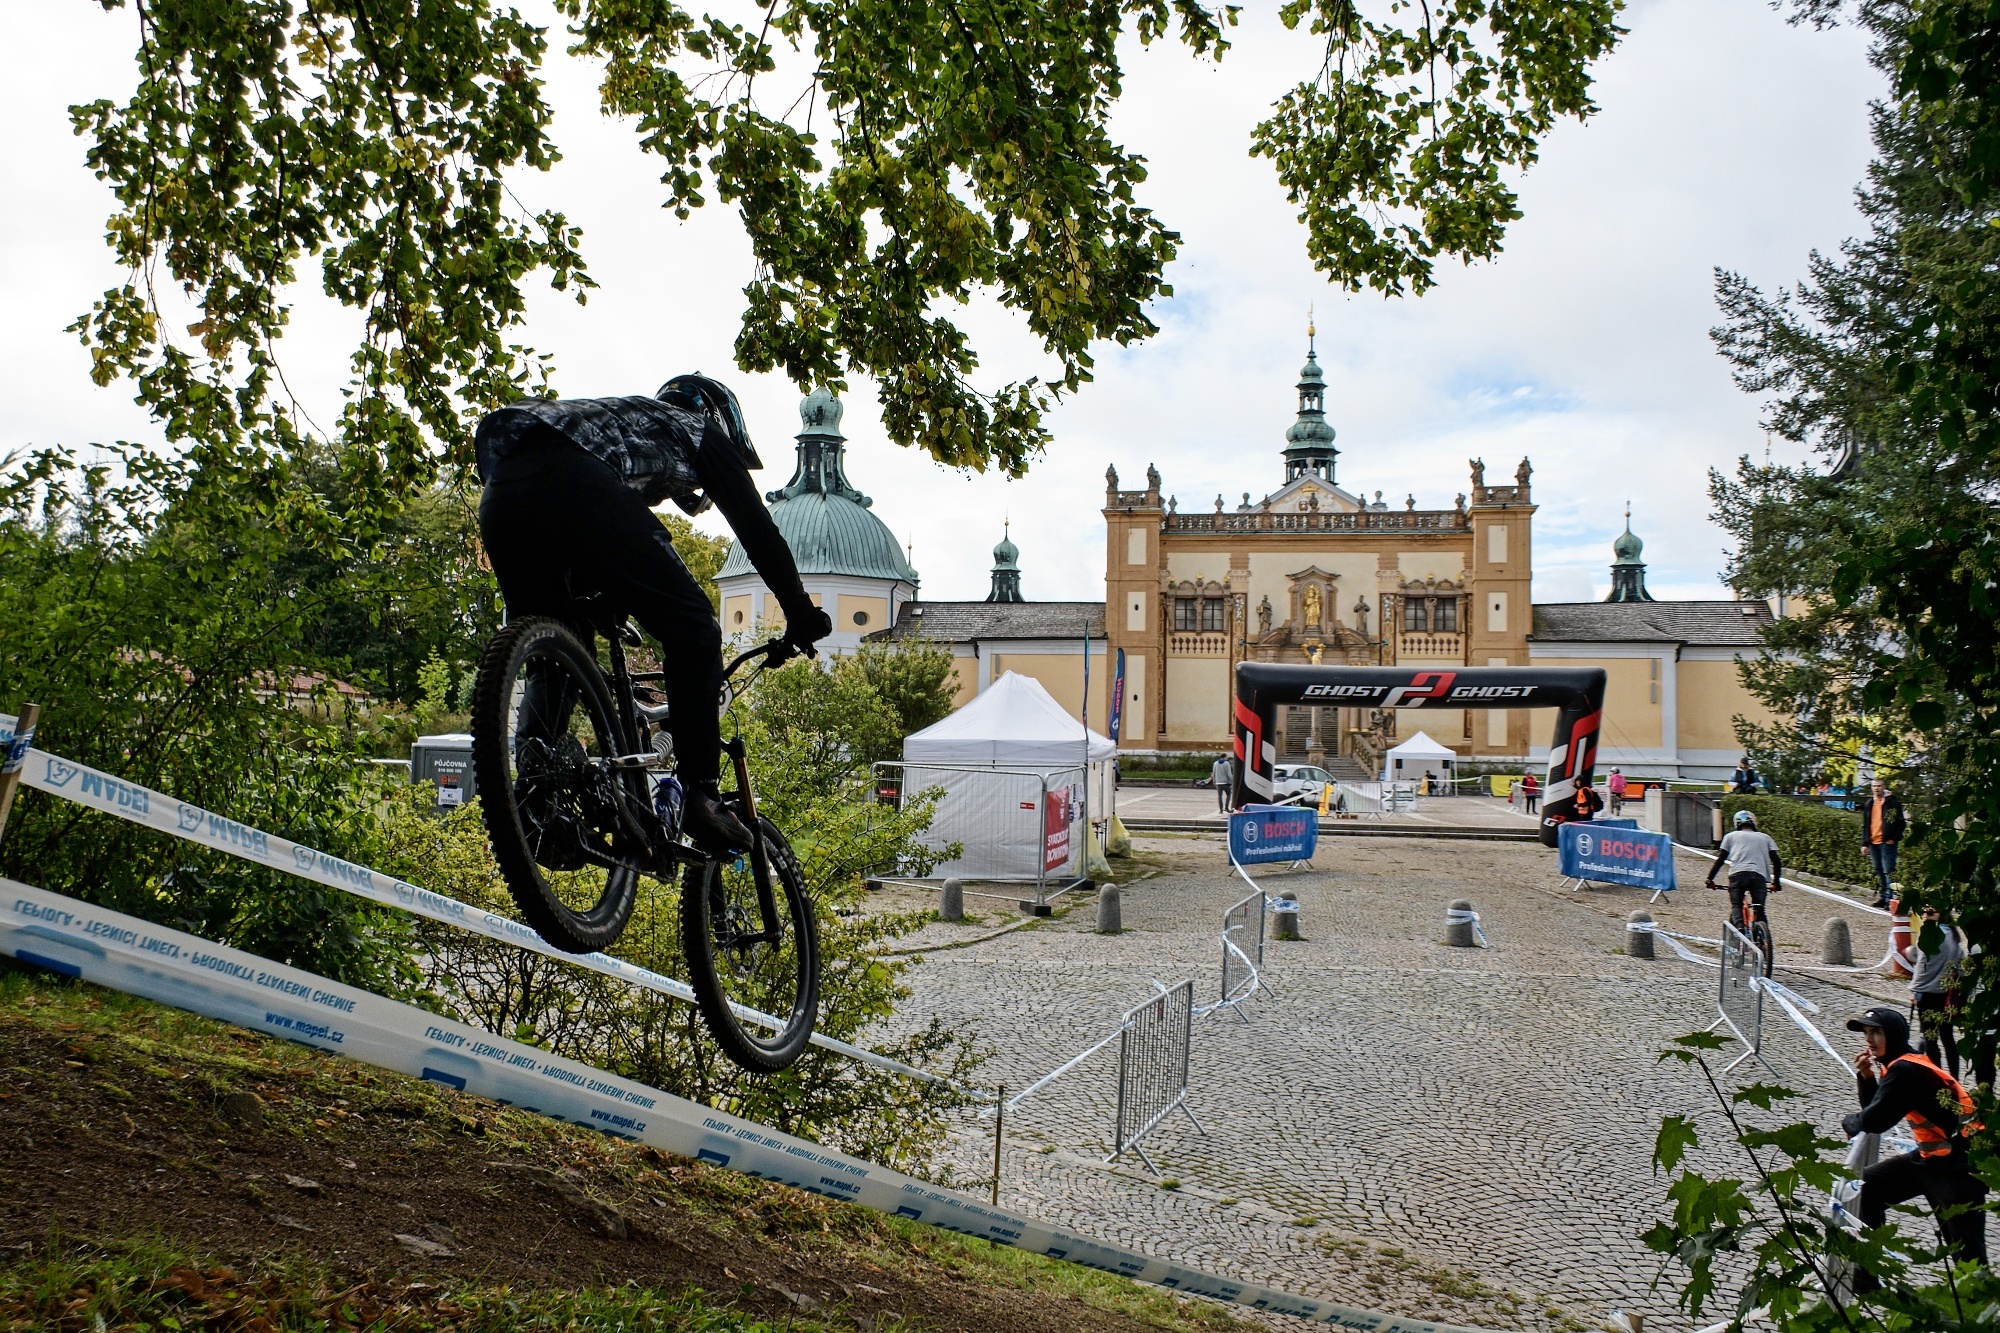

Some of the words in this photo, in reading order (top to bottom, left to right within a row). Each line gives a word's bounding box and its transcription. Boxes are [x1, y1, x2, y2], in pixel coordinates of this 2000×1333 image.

[1304, 684, 1388, 697] GHOST
[1450, 685, 1538, 697] GHOST
[434, 758, 467, 768] PŮJČOVNA
[1263, 821, 1307, 839] BOSCH
[1600, 838, 1659, 862] BOSCH
[265, 1012, 345, 1043] www.mapei.cz
[590, 1109, 647, 1133] www.mapei.cz
[820, 1176, 861, 1193] www.mapei.cz
